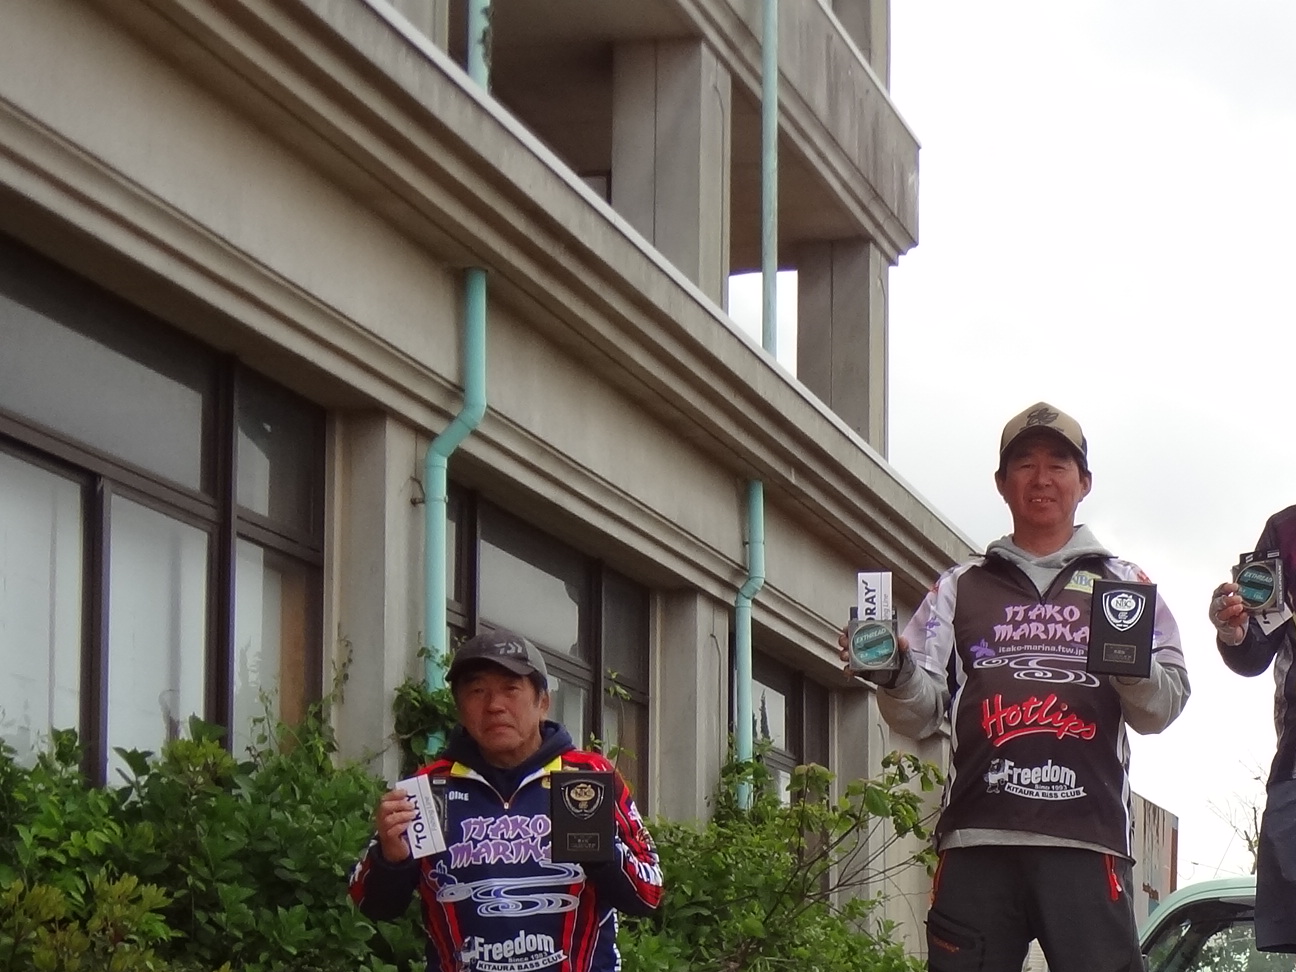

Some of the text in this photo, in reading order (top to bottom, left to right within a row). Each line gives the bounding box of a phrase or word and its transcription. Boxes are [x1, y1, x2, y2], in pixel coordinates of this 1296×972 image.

[861, 578, 877, 622] RAY
[1004, 603, 1081, 623] ITAKO
[993, 621, 1090, 643] MARINA
[981, 693, 1097, 743] Hotlips
[1004, 759, 1077, 789] Freedom
[448, 790, 470, 802] OIKE
[1006, 783, 1041, 798] KITAURA
[1060, 789, 1082, 798] CLUB
[461, 814, 552, 842] ITAKO
[474, 929, 555, 962] Freedom
[478, 953, 563, 972] KITAURA BASS CLUB
